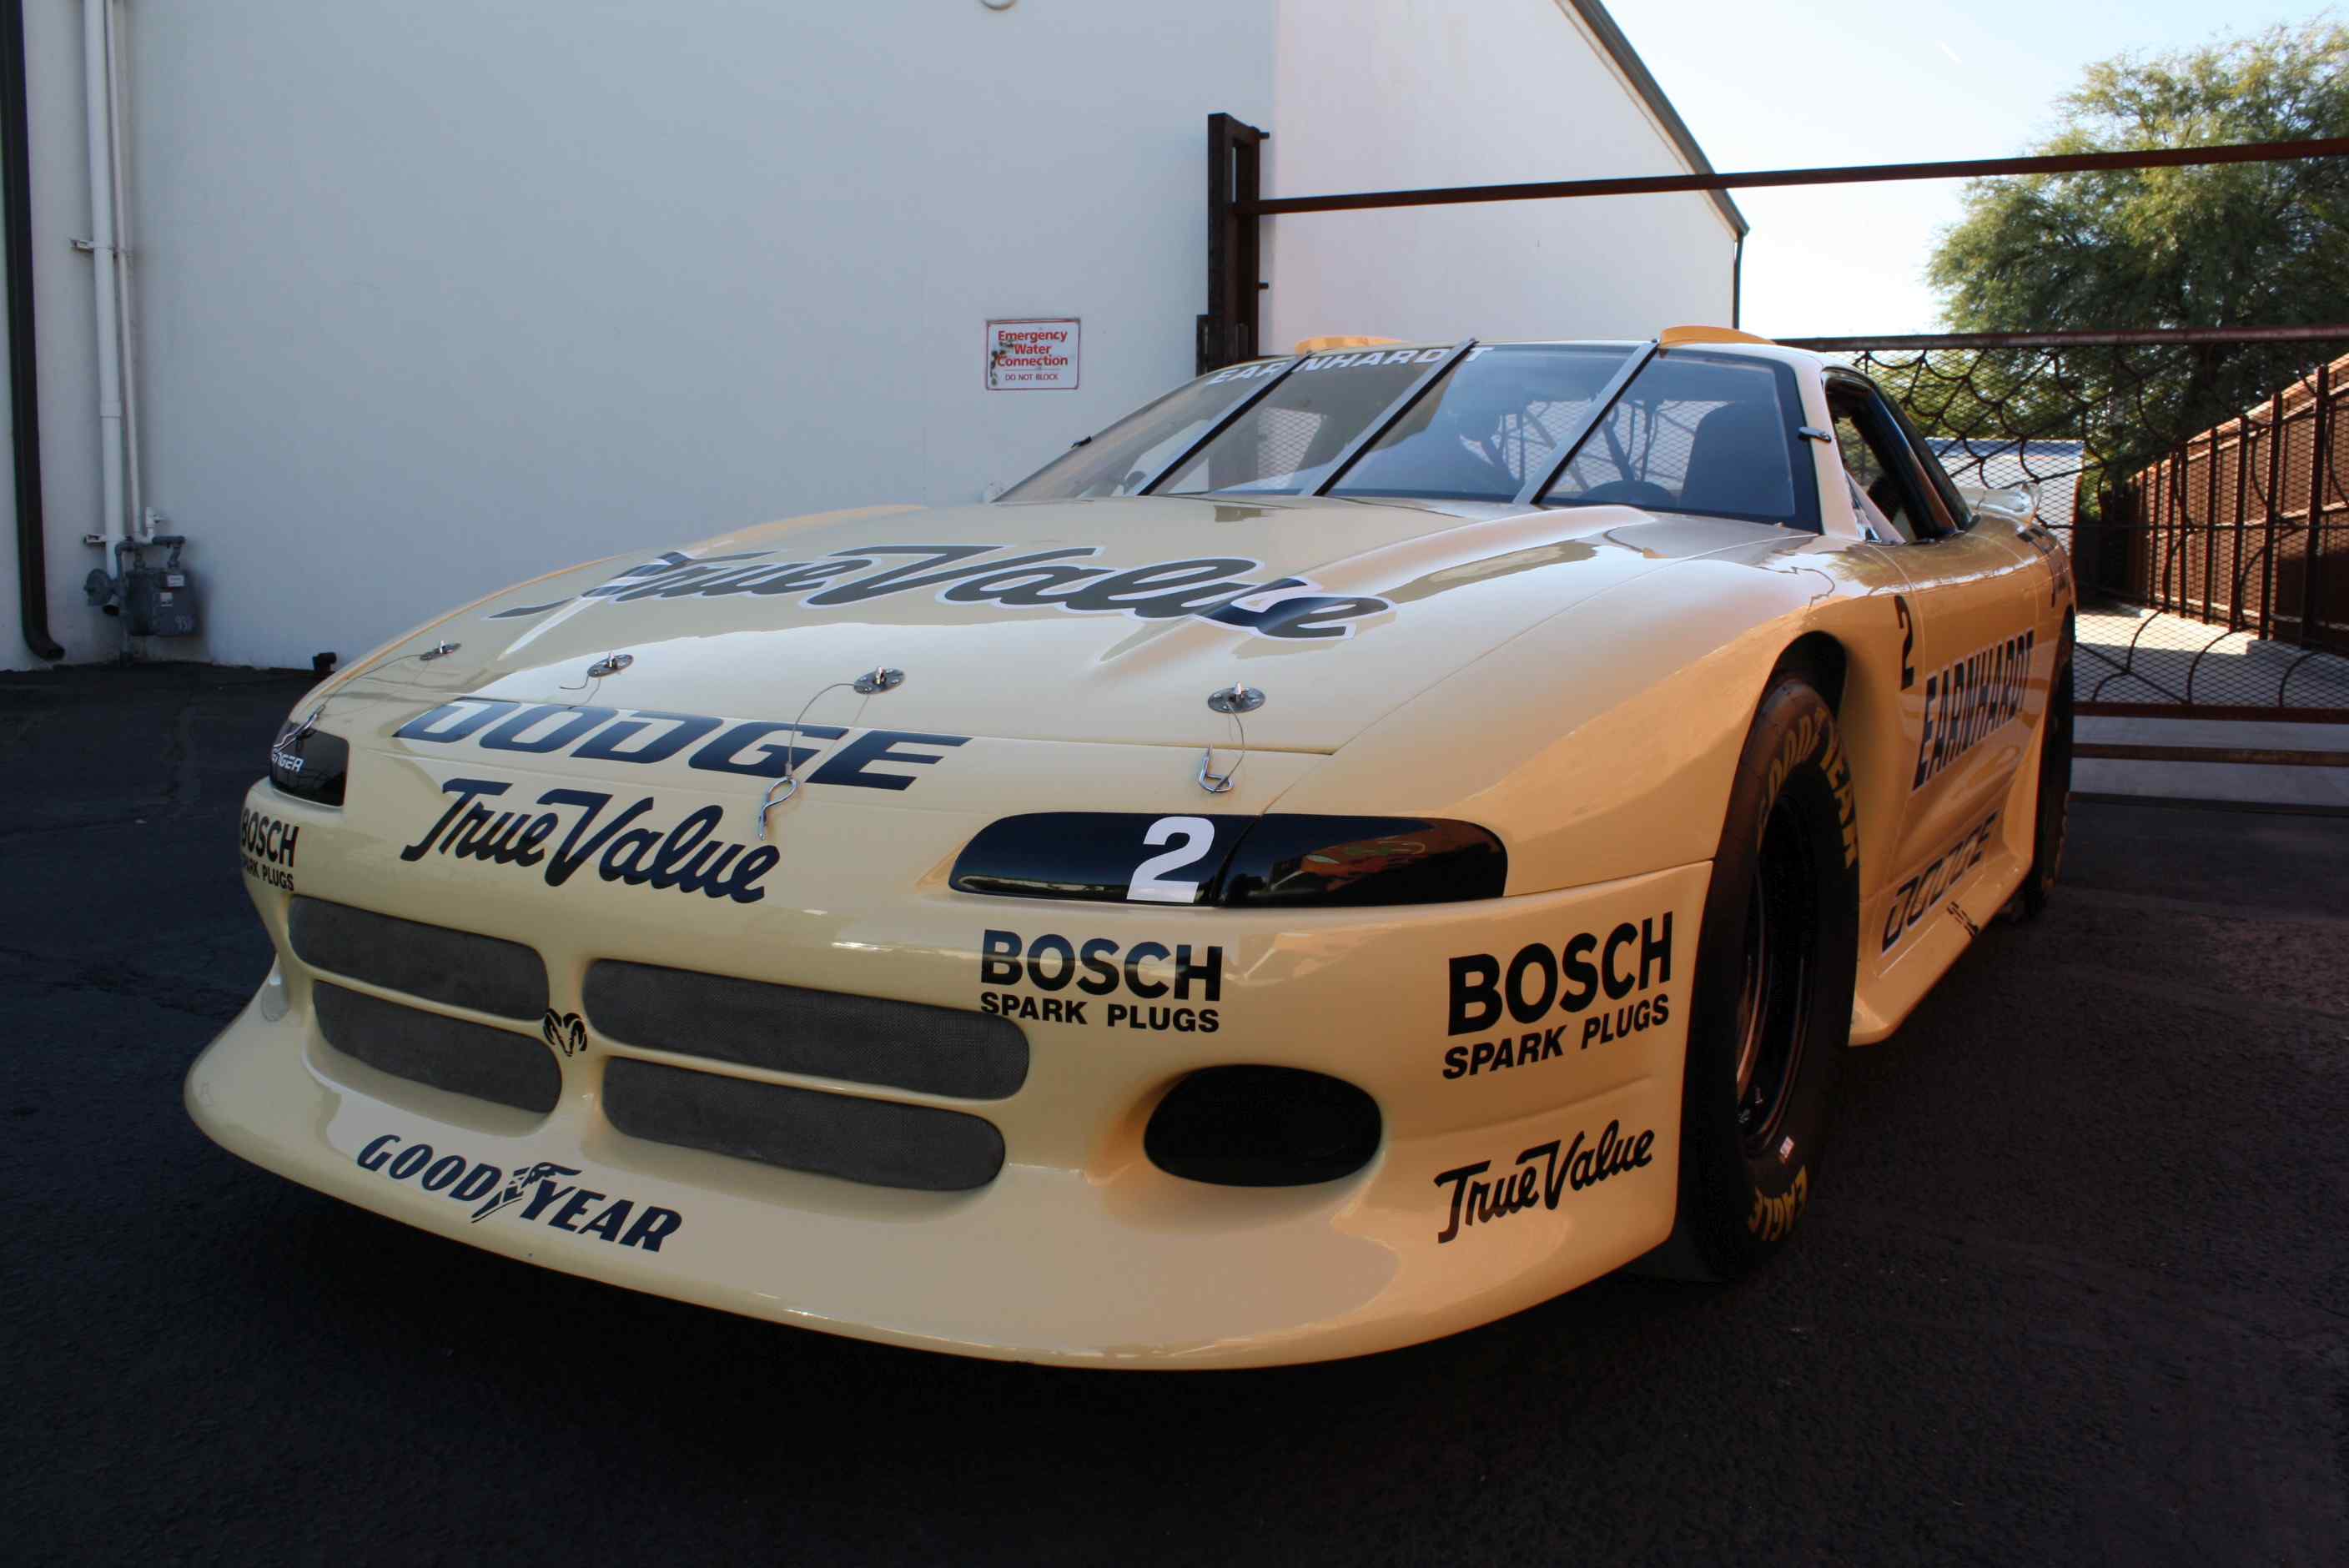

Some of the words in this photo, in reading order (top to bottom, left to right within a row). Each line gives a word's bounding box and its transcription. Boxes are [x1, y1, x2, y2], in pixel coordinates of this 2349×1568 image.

[997, 354, 1069, 367] Connection
[998, 330, 1068, 343] Emergency
[1014, 344, 1052, 354] Water
[1894, 595, 1914, 691] 2
[392, 697, 973, 791] DODGE
[1912, 629, 2034, 792] EARNHARDT
[241, 807, 299, 867] BOSCH
[1127, 817, 1215, 903] 2
[262, 864, 294, 892] PLUGS
[981, 929, 1223, 1002] BOSCH
[1448, 911, 1672, 1036] BOSCH
[981, 992, 1088, 1024] SPARK
[1108, 1003, 1219, 1033] PLUGS
[1442, 1025, 1567, 1080] SPARK
[1581, 993, 1669, 1050] PLUGS
